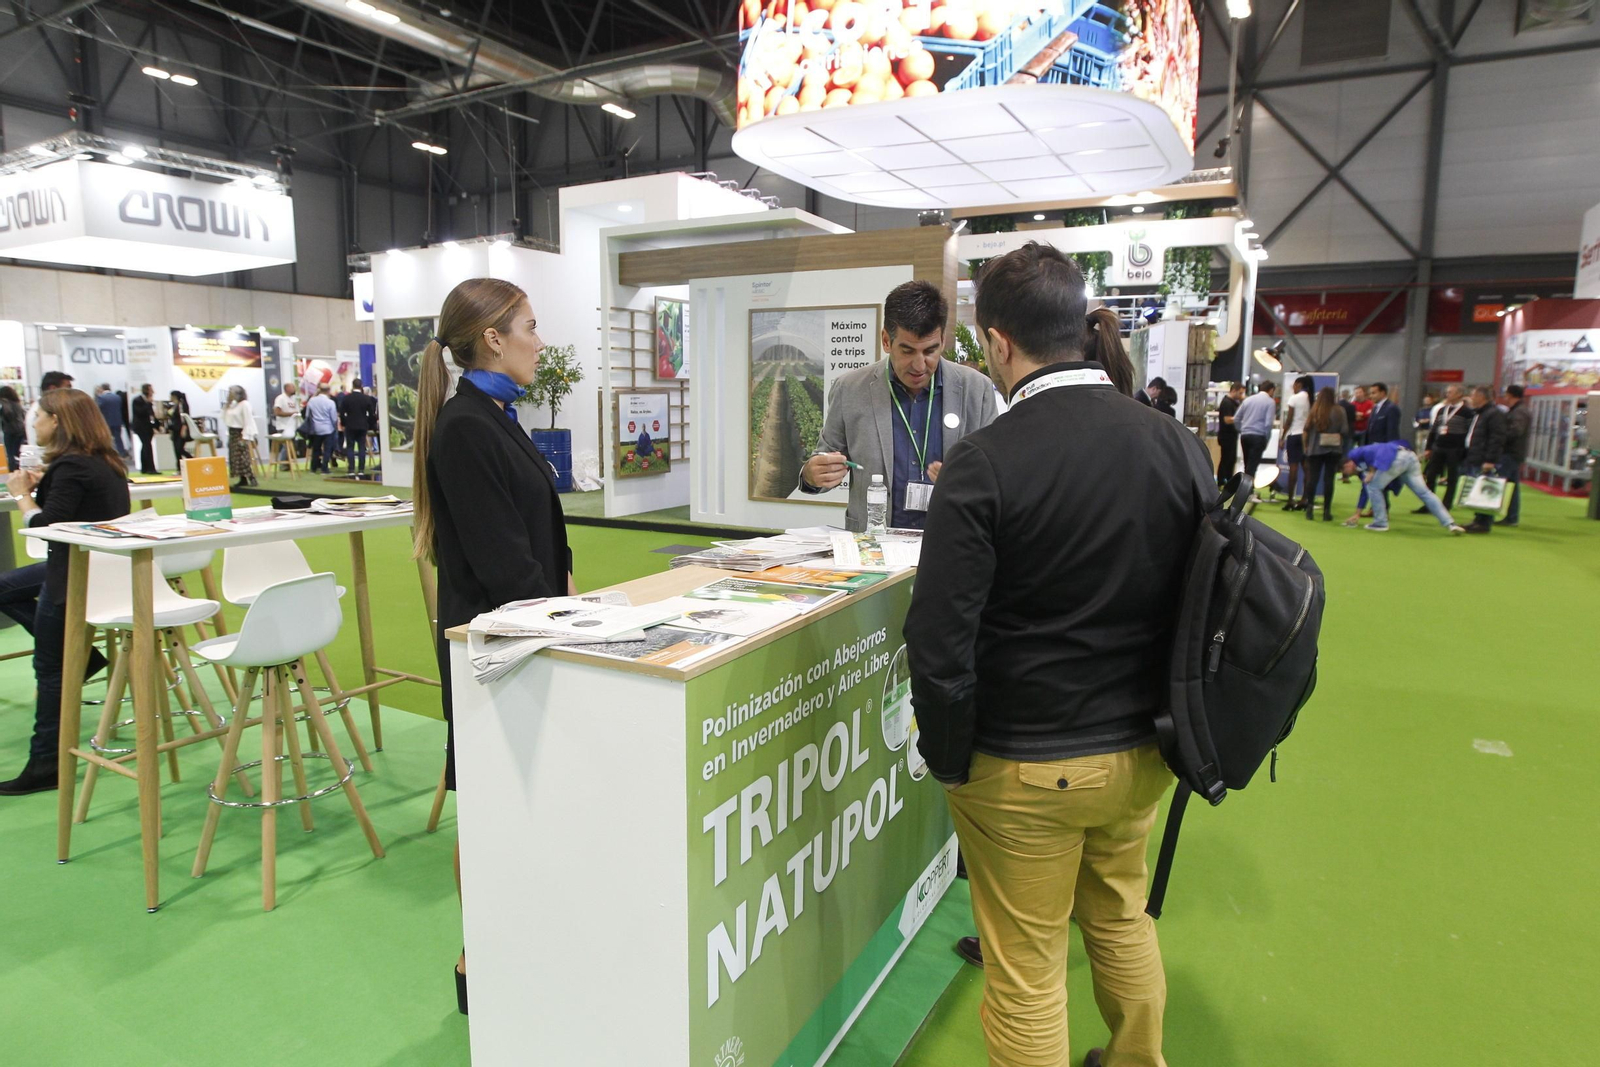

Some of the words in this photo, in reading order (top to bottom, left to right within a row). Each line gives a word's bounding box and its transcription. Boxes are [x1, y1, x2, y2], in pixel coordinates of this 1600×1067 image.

[119, 189, 269, 241] CROWN
[1127, 268, 1152, 281] bejo
[831, 321, 867, 330] Máximo
[831, 333, 863, 343] control
[831, 347, 843, 356] de
[845, 347, 865, 358] trips
[831, 362, 836, 371] y
[702, 673, 803, 745] Polinización
[806, 658, 830, 684] con
[833, 627, 887, 670] Abejorros
[702, 752, 726, 781] en
[732, 692, 824, 764] Invernadero
[827, 684, 835, 708] y
[838, 671, 861, 696] Aire
[864, 651, 890, 679] Libre
